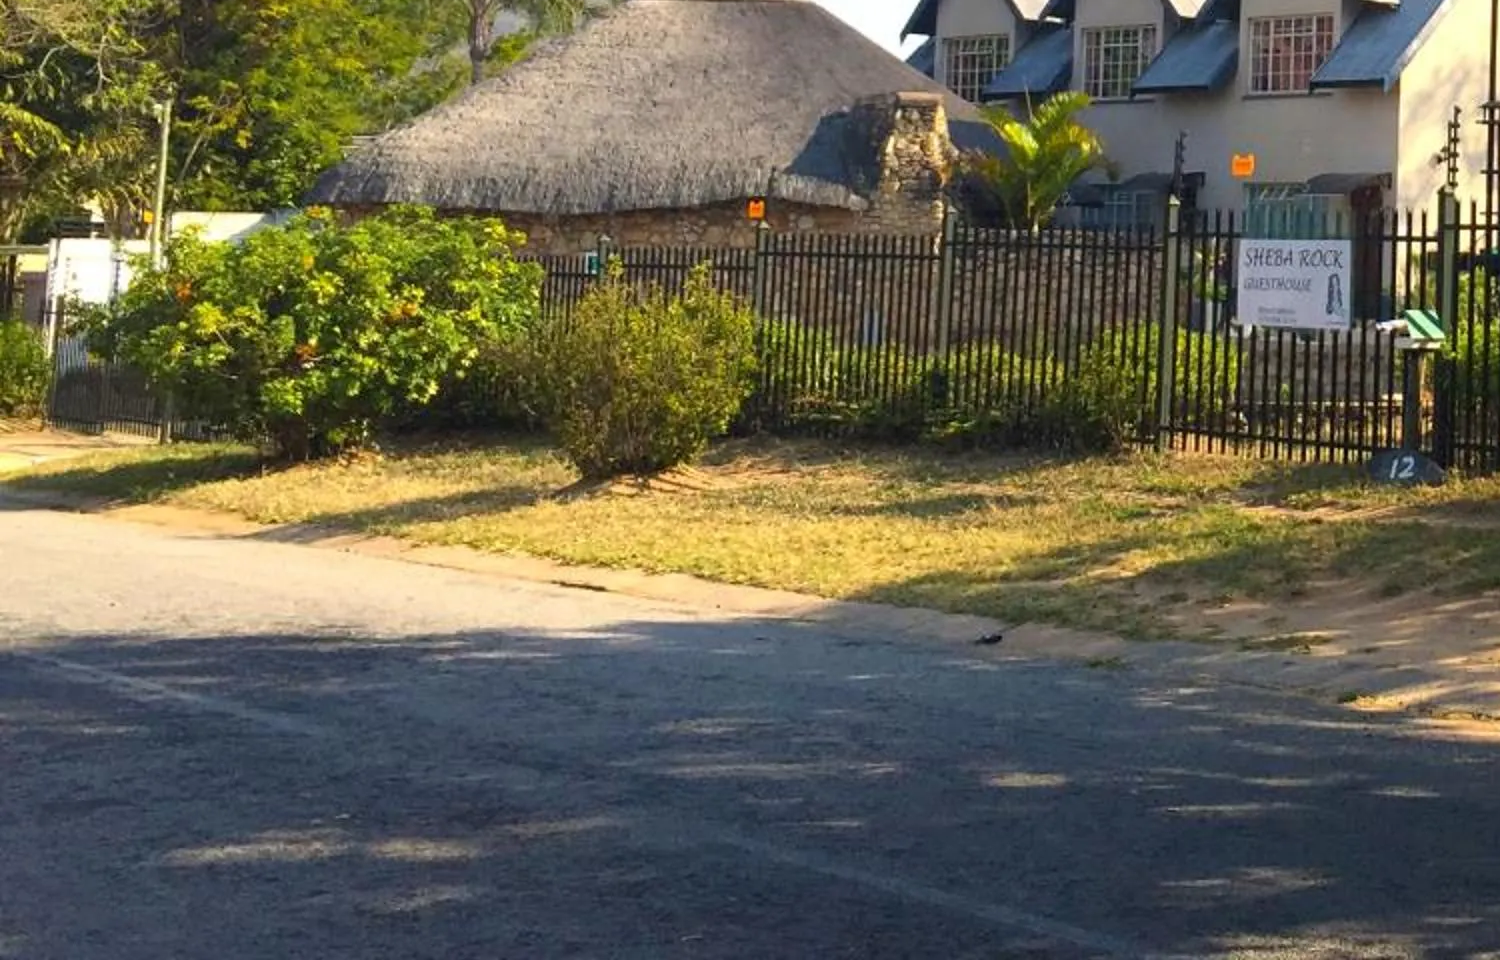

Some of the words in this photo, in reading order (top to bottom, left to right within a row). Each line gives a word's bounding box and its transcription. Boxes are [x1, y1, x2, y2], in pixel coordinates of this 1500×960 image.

[1244, 247, 1293, 268] SHEBA
[1299, 248, 1343, 269] ROCK
[1243, 276, 1312, 292] GUESTHOUSE
[1388, 455, 1415, 480] 12
